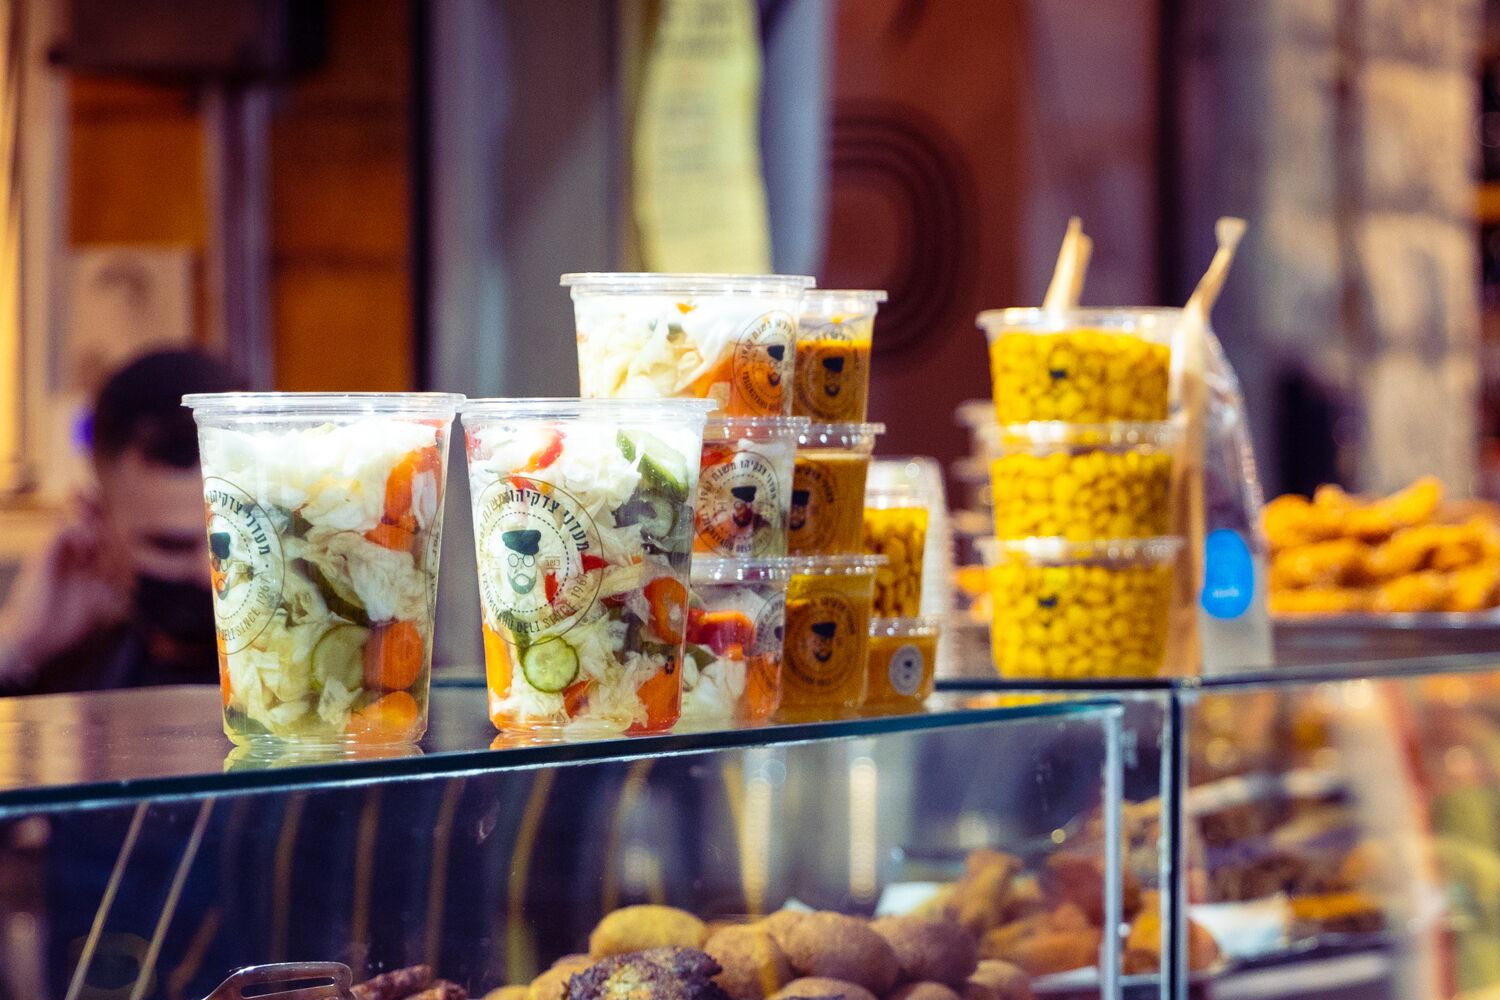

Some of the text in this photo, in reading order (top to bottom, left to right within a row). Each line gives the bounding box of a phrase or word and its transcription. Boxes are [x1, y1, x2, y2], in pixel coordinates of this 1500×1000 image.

[509, 490, 560, 514] צדקיהו
[246, 511, 271, 556] מעדני
[563, 511, 590, 551] מעדני
[236, 606, 261, 637] SINCE
[516, 620, 541, 634] DELI
